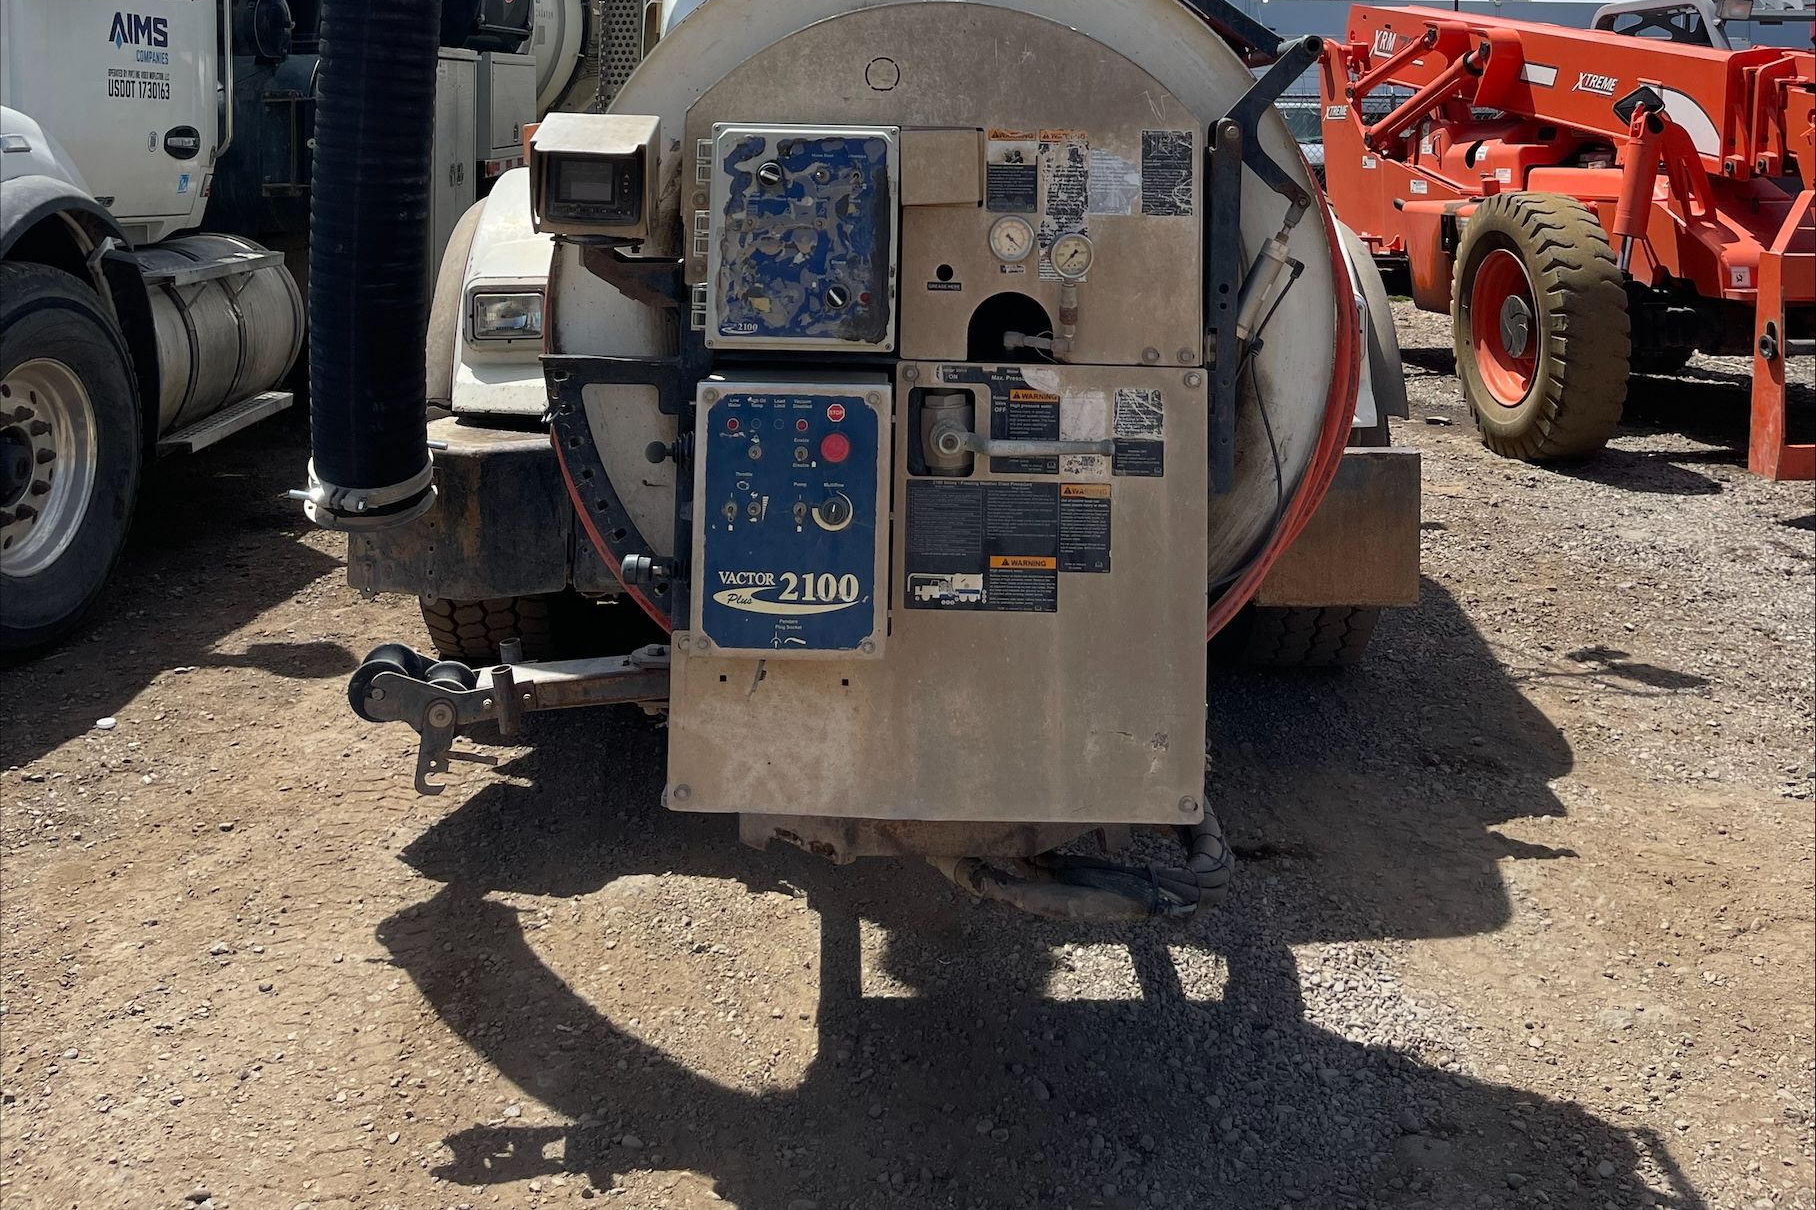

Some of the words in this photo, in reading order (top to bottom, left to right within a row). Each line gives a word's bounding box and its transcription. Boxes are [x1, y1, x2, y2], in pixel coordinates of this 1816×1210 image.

[109, 12, 168, 48] AIMS
[1369, 30, 1397, 58] XRM
[136, 50, 169, 65] COMPANIES
[108, 79, 136, 98] USDOT
[138, 81, 170, 100] 1730163
[1572, 72, 1619, 95] XTREME
[1323, 105, 1349, 121] XTREME
[737, 323, 758, 331] 2100
[1021, 392, 1058, 401] WARNING
[718, 571, 776, 586] VACTOR
[778, 572, 860, 603] 2100
[727, 593, 753, 605] Plus
